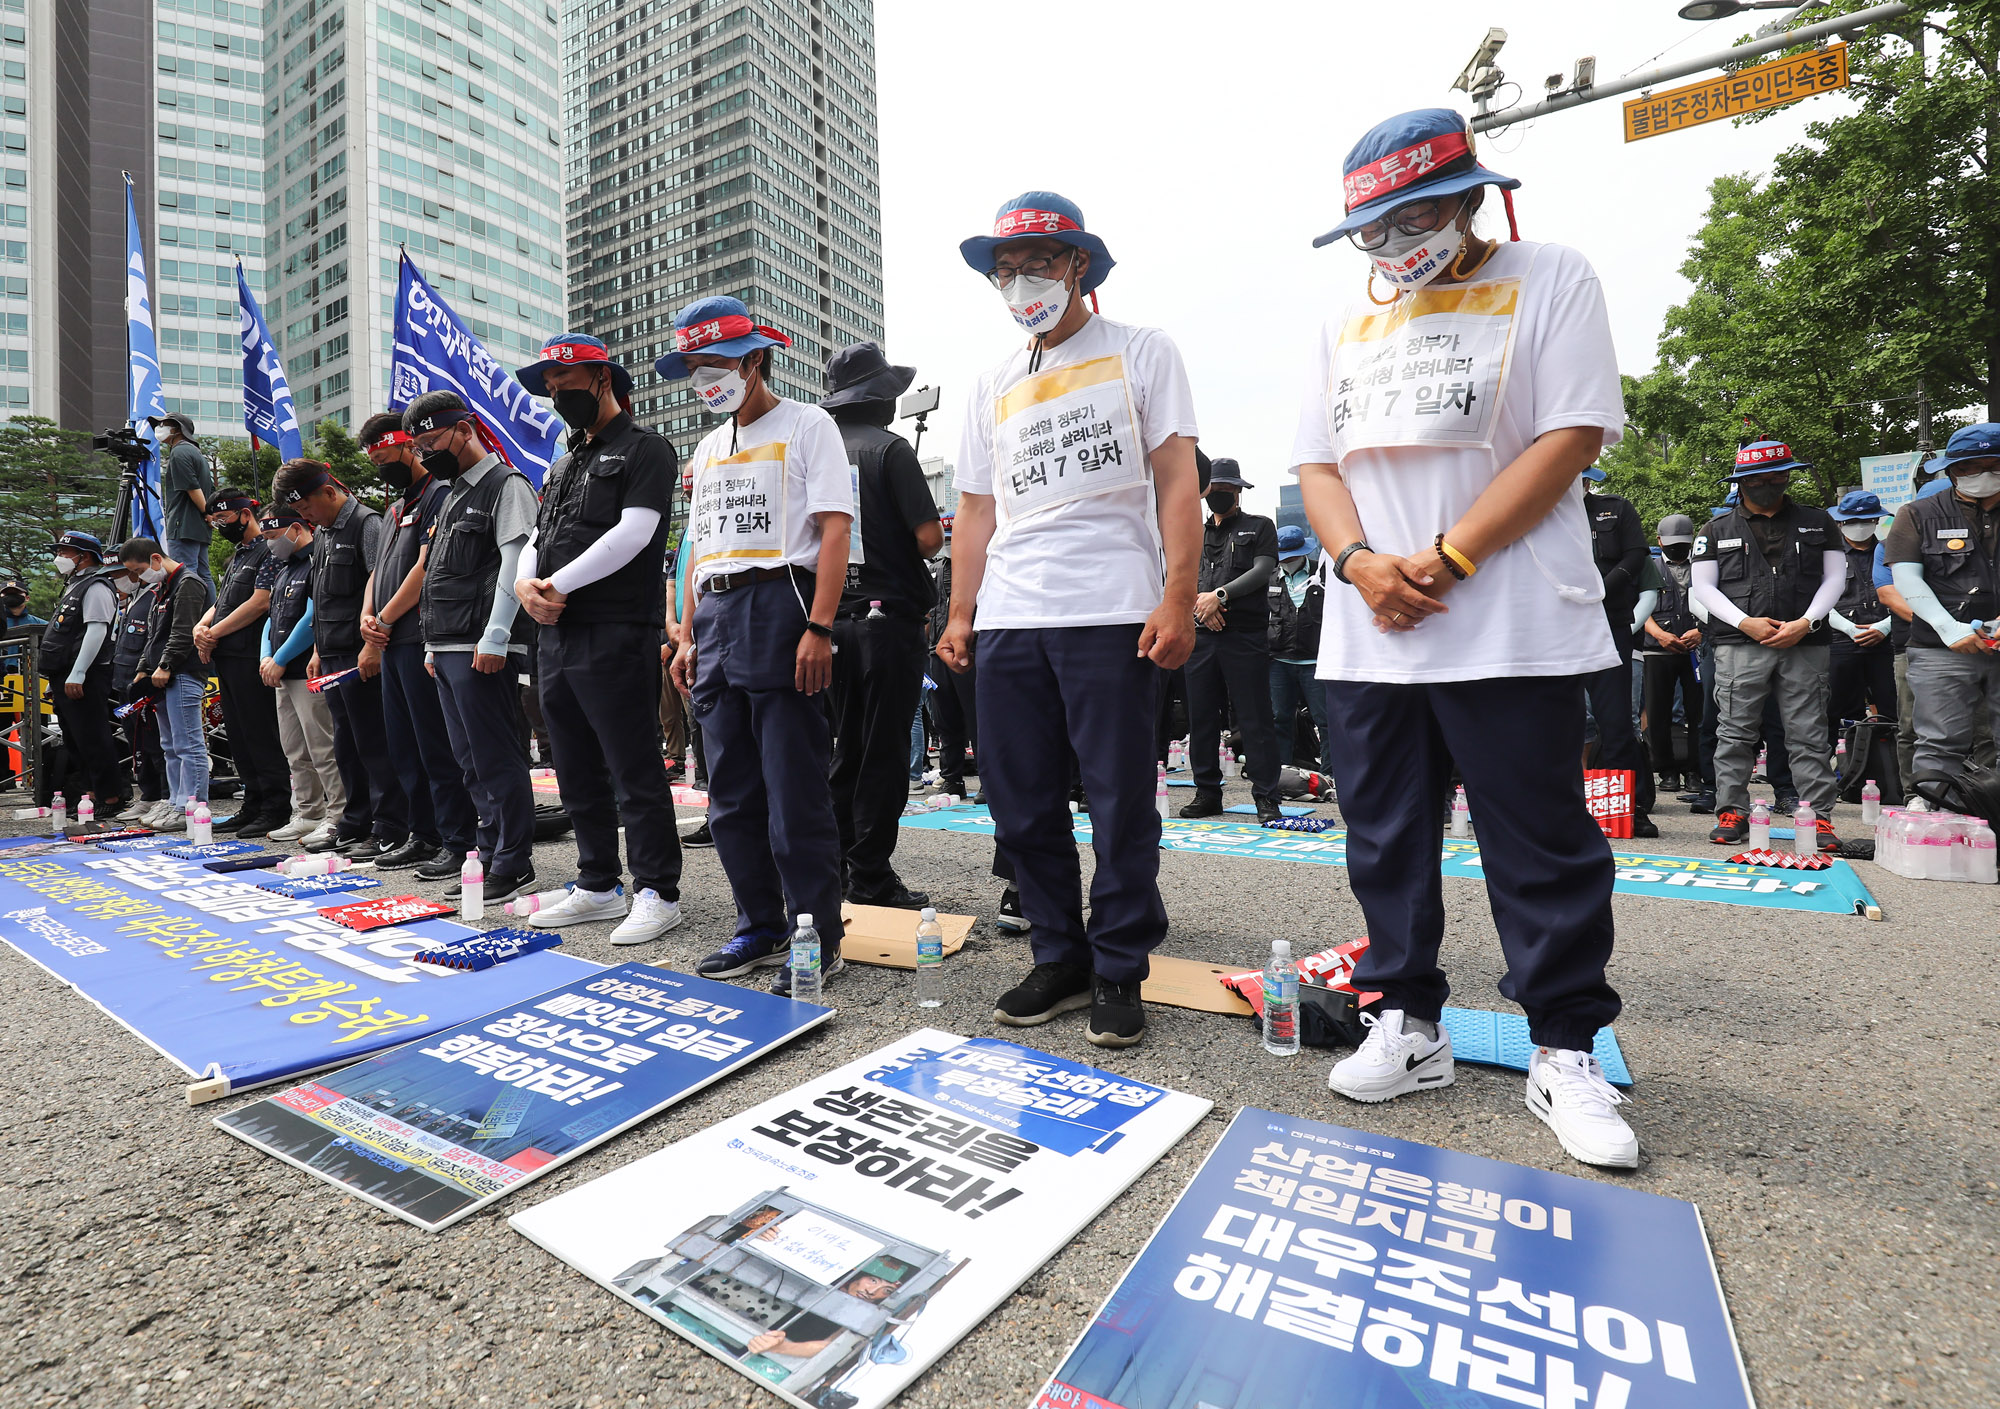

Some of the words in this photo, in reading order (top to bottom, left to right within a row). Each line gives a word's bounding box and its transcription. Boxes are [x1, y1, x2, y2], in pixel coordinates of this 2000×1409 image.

[1631, 55, 1840, 136] 불법주정차무인단속중
[1379, 142, 1434, 187] 투쟁
[1018, 210, 1060, 232] 투쟁
[1393, 247, 1429, 273] 노동자
[550, 346, 574, 360] 투쟁
[689, 320, 723, 345] 투쟁
[1406, 333, 1460, 356] 정부가
[1401, 356, 1474, 381] 살려내라
[1018, 418, 1054, 443] 윤석열
[1057, 403, 1096, 428] 정부가
[1333, 392, 1370, 434] 단식
[1384, 389, 1402, 417] 7
[1414, 381, 1477, 416] 일차
[1012, 438, 1056, 466] 조선하청
[1060, 420, 1113, 448] 살려내라
[1766, 447, 1785, 459] 투쟁
[725, 476, 756, 492] 정부가
[1011, 459, 1048, 497] 단식
[1053, 455, 1068, 478] 7
[1078, 440, 1123, 472] 일차
[718, 514, 728, 534] 7
[735, 511, 772, 534] 일차
[725, 493, 767, 510] 살려내라
[1693, 535, 1708, 557] 6
[1586, 793, 1631, 817] 전환!
[83, 854, 238, 891] 금속노조
[160, 880, 333, 923] 총파업
[114, 915, 250, 958] 대우조선
[191, 948, 358, 1008] 하청투쟁
[585, 978, 745, 1026] 하청노동자
[482, 1012, 660, 1074] 정상으로
[534, 992, 668, 1038] 빼앗긴
[646, 1022, 754, 1062] 임금
[418, 1033, 625, 1107] 회복하라!
[938, 1045, 1163, 1109] 대우조선하청
[934, 1068, 1098, 1119] 투쟁승리!
[812, 1085, 1041, 1175] 생존권을
[1290, 1128, 1396, 1160] 전국금속노동조합
[441, 1147, 467, 1164] 임금
[468, 1155, 486, 1171] 30%
[743, 1143, 819, 1182] 전국금속노동조합
[751, 1109, 1024, 1220] 보장하라!
[1248, 1140, 1575, 1242] 산업은행이
[1232, 1168, 1499, 1264] 책임지고
[1200, 1203, 1697, 1386] 대우조선이
[1172, 1252, 1632, 1409] 해결하라!
